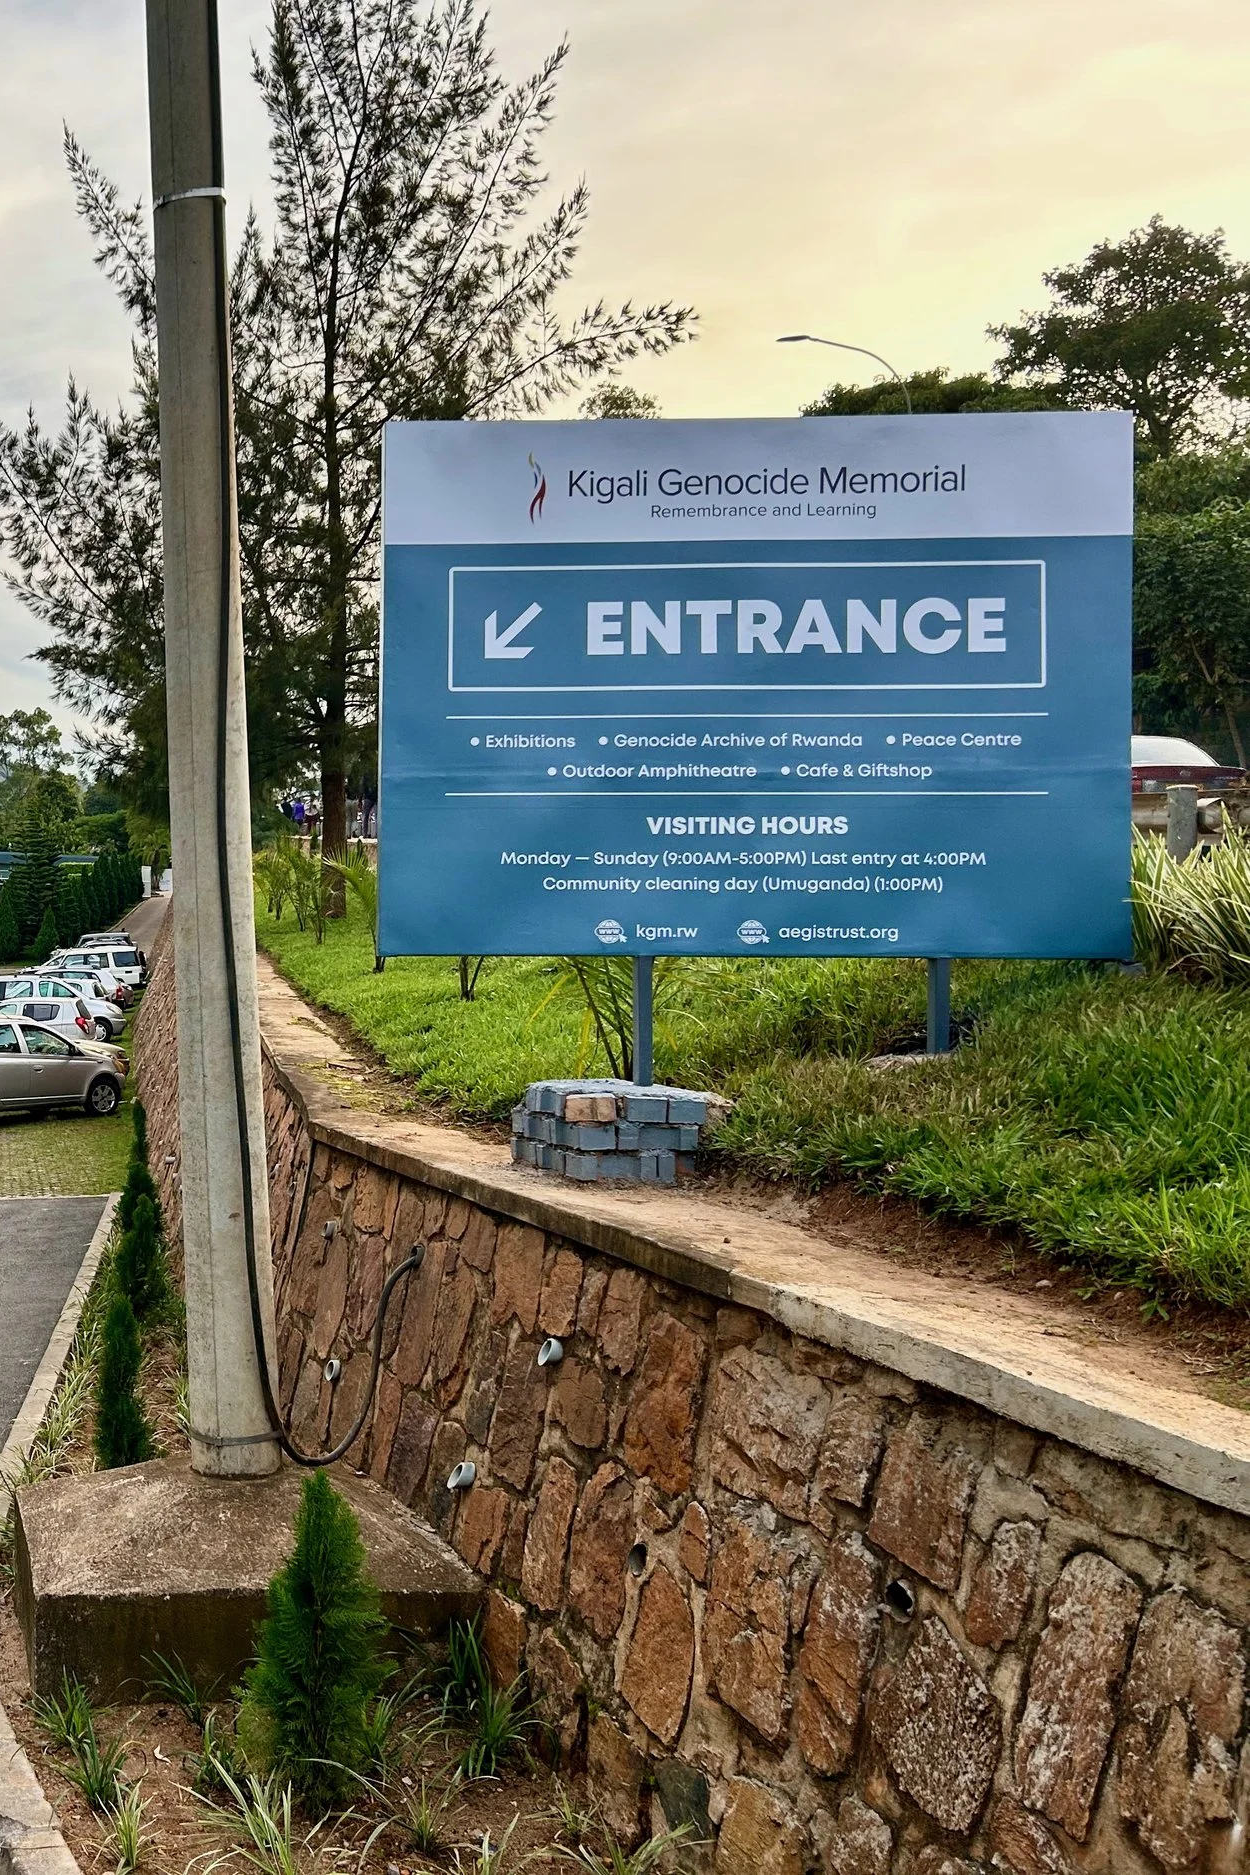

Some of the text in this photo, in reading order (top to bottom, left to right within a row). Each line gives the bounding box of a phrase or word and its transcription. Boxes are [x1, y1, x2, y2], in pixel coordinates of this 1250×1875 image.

[569, 464, 965, 504] Kigali Genocide Memorial
[652, 504, 876, 518] Remembrance and Learning
[587, 598, 1006, 655] ENTRANCE
[486, 735, 575, 747] Exhibitions
[614, 733, 862, 747] Genocide Archive of Rwanda
[903, 733, 1022, 746] Peace Centre
[563, 764, 757, 780] Outdoor Amphitheatre
[797, 764, 932, 779] Cafe & Giftshop
[646, 816, 848, 834] VISITING HOURS
[501, 852, 571, 867] Monday
[594, 852, 659, 867] Sunday
[663, 851, 806, 866] (9:00AM-5:00PM)
[811, 852, 847, 865] Last
[852, 854, 896, 868] entry
[901, 854, 919, 864] at
[924, 852, 986, 865] 4:00PM
[543, 876, 943, 893] Community cleaning day (Umuganda) (1:00PM)
[598, 927, 620, 935] www
[637, 925, 698, 940] kgm.rw
[740, 927, 762, 935] www
[779, 925, 898, 941] aegistrust.org
